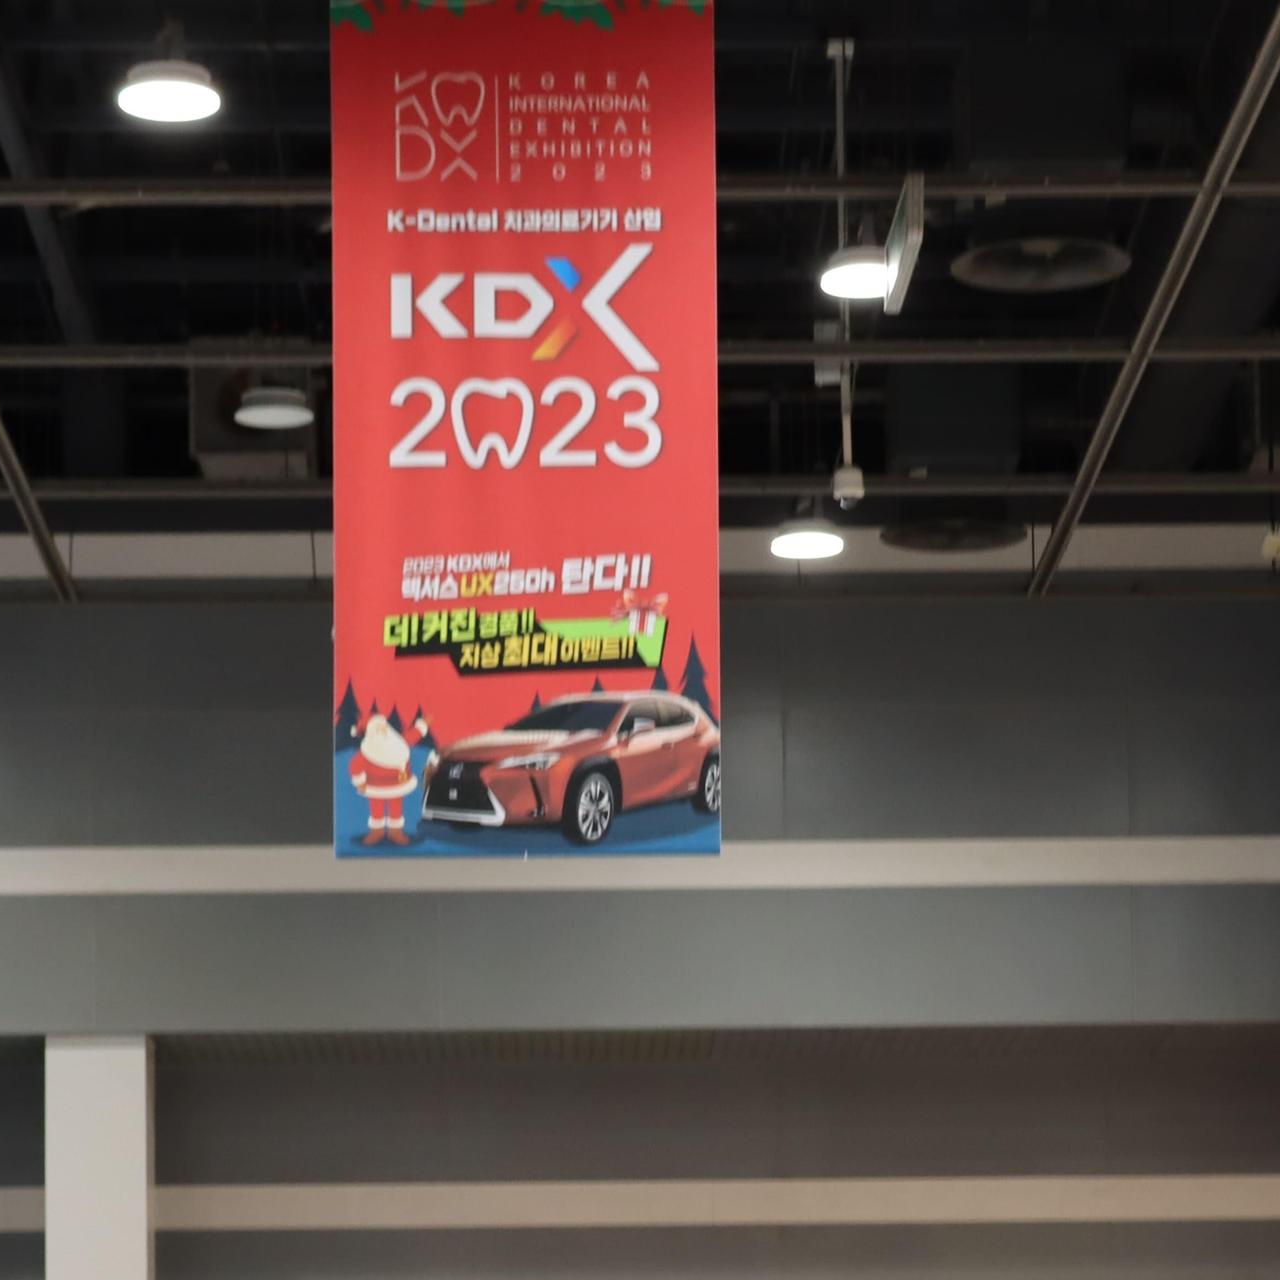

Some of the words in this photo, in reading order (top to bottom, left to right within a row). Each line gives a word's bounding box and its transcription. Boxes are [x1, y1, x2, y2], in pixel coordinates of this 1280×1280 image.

[509, 72, 650, 89] KOREA
[509, 95, 650, 112] INTERNATIONAL
[509, 119, 650, 135] DENTAL
[510, 140, 652, 158] EXHIBITION
[510, 165, 652, 181] 2023
[387, 209, 498, 232] K-Dental
[504, 208, 618, 232] 치과의료기기
[624, 208, 662, 232] 산업
[390, 243, 660, 372] KDX
